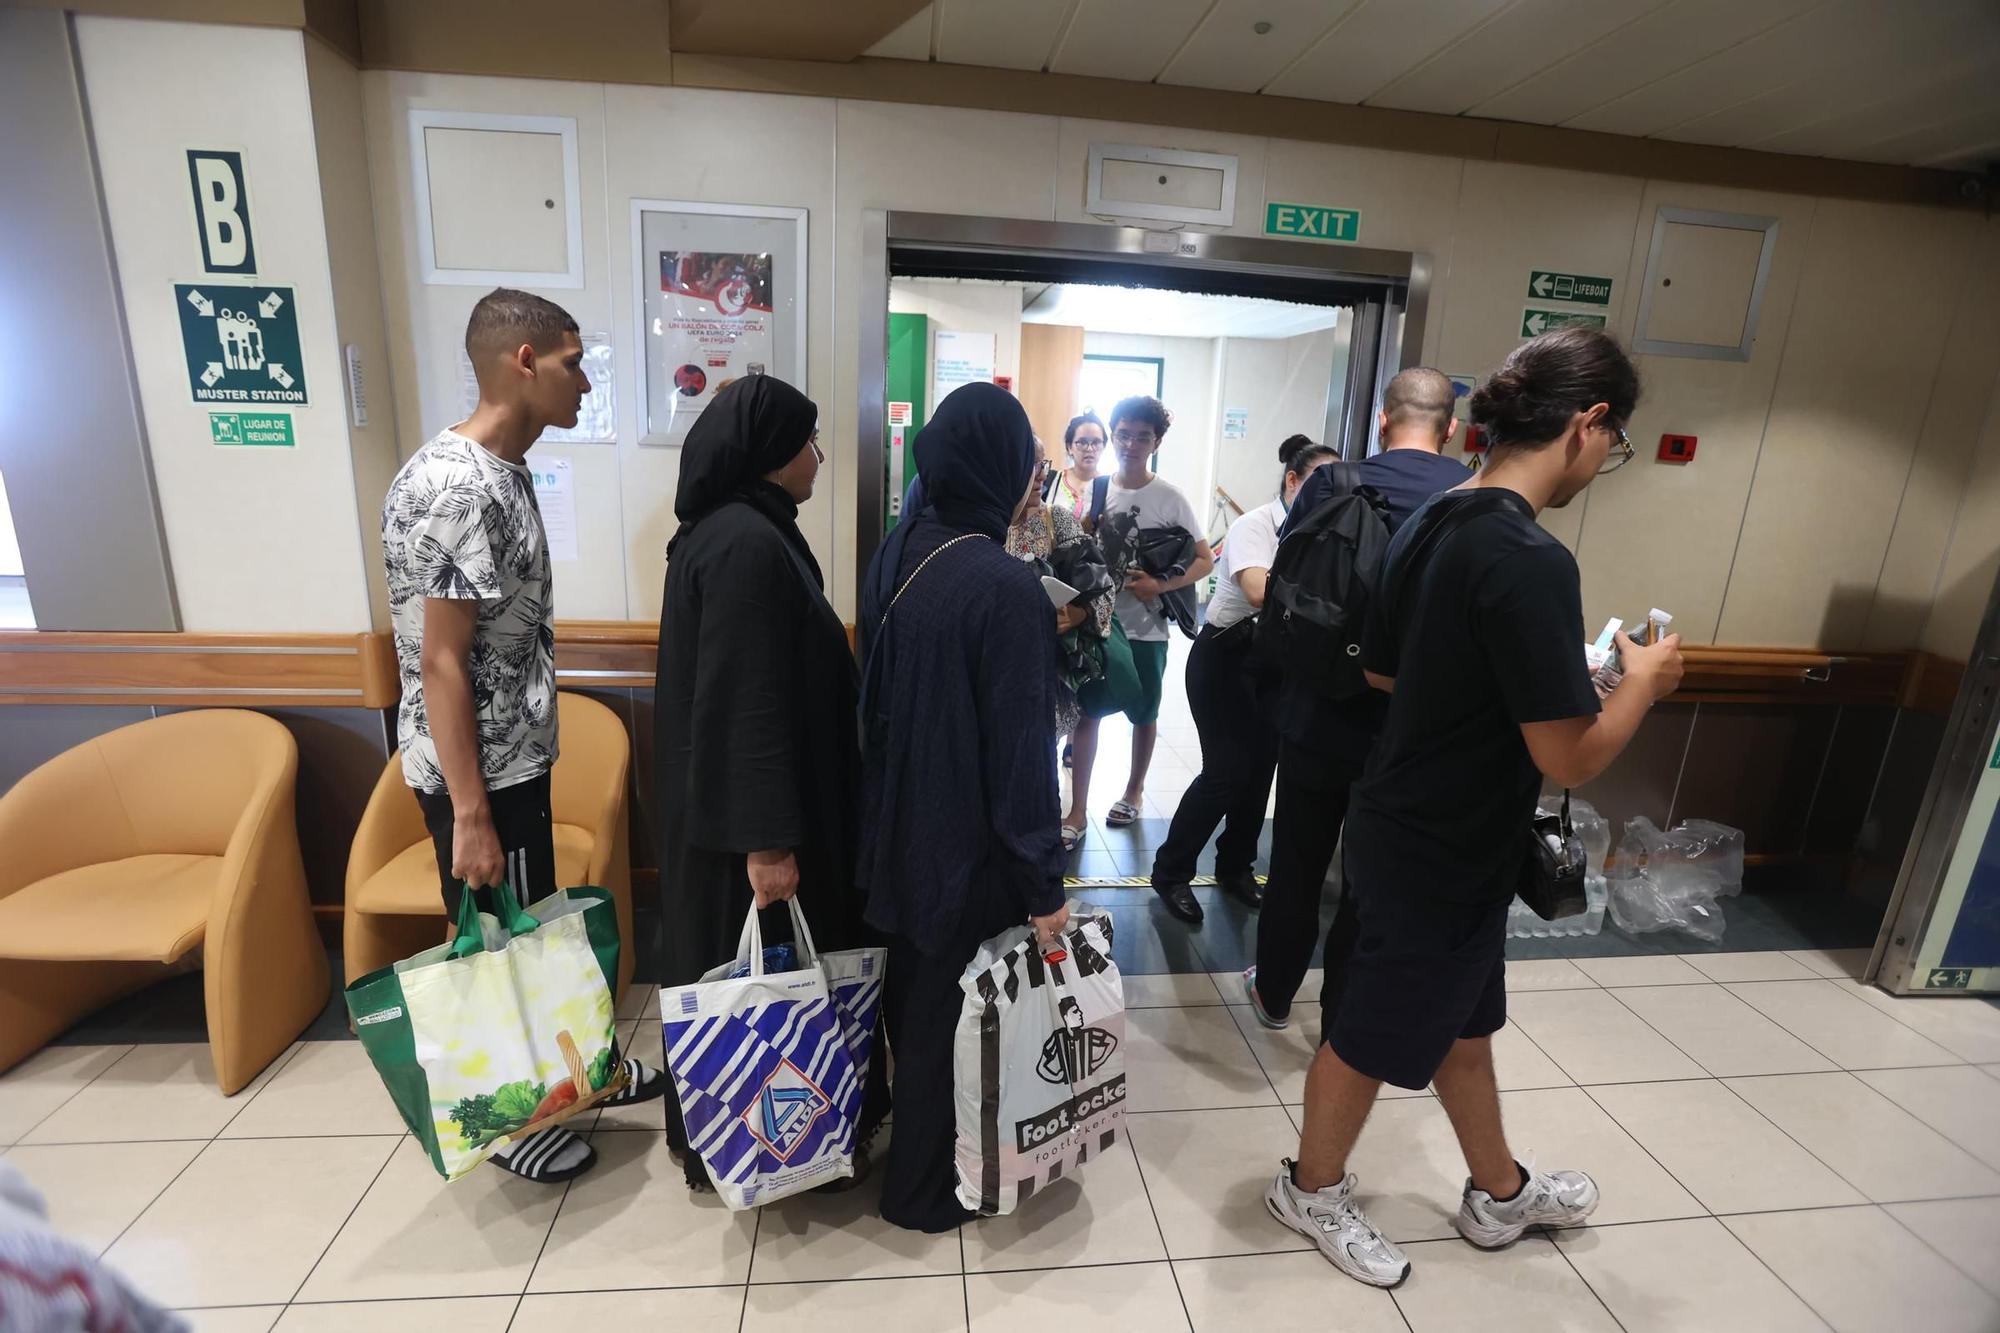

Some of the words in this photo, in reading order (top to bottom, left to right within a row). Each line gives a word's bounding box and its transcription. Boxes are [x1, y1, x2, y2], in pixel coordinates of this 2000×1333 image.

[195, 158, 247, 267] B
[1275, 207, 1352, 237] EXIT
[1574, 283, 1609, 297] LIFEBOAT
[196, 389, 249, 399] MUSTER
[251, 390, 303, 401] STATION
[243, 420, 272, 430] LUGAR
[274, 420, 286, 429] DE
[783, 1099, 820, 1148] ALDI
[1022, 1108, 1069, 1148] Foot
